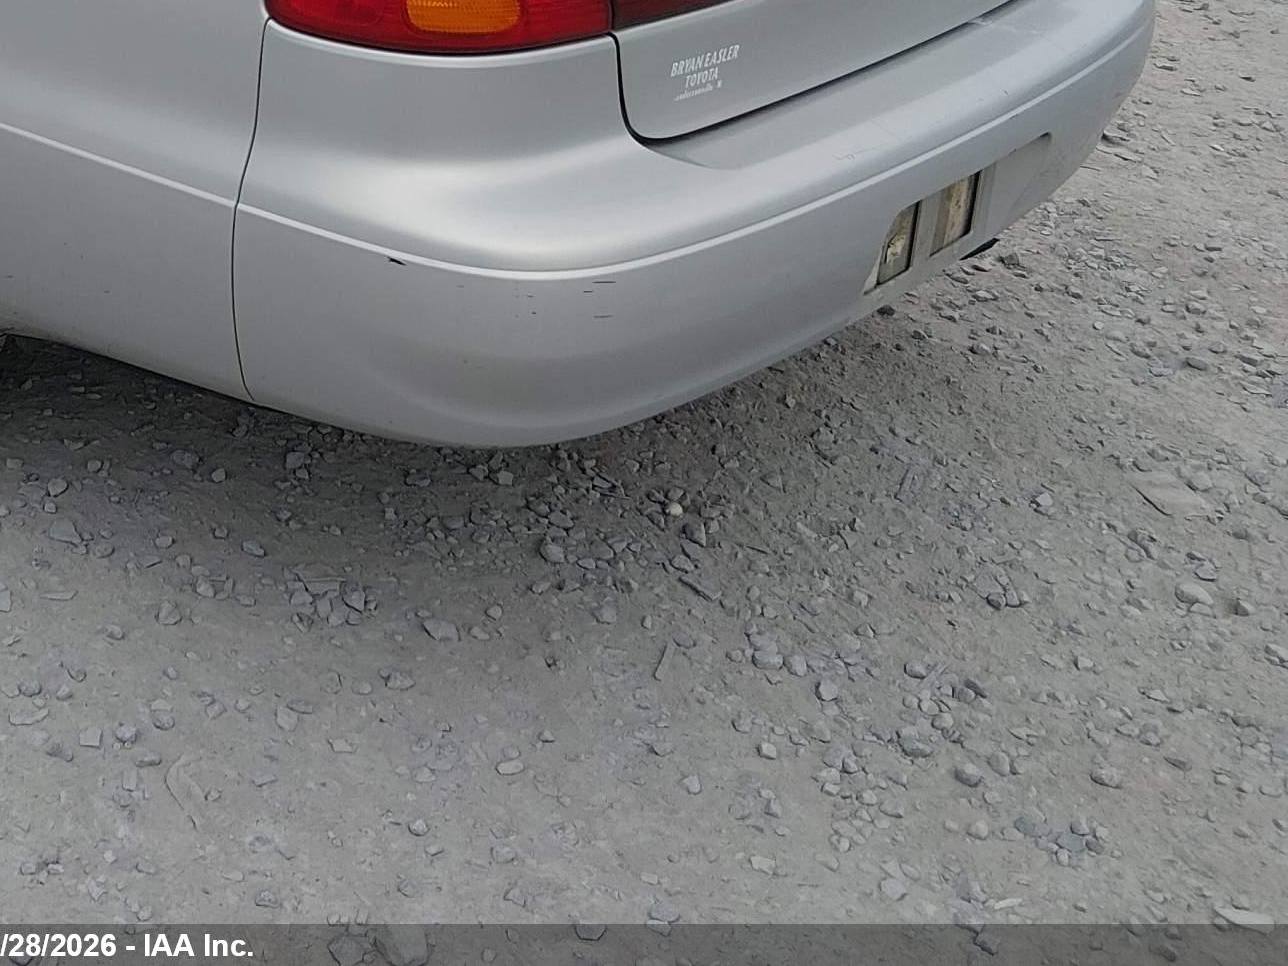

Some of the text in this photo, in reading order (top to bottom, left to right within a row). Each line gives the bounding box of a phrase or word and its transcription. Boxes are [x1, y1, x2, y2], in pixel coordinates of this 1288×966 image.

[670, 44, 740, 77] BRYAN EASLER
[685, 66, 719, 89] TOYOTA
